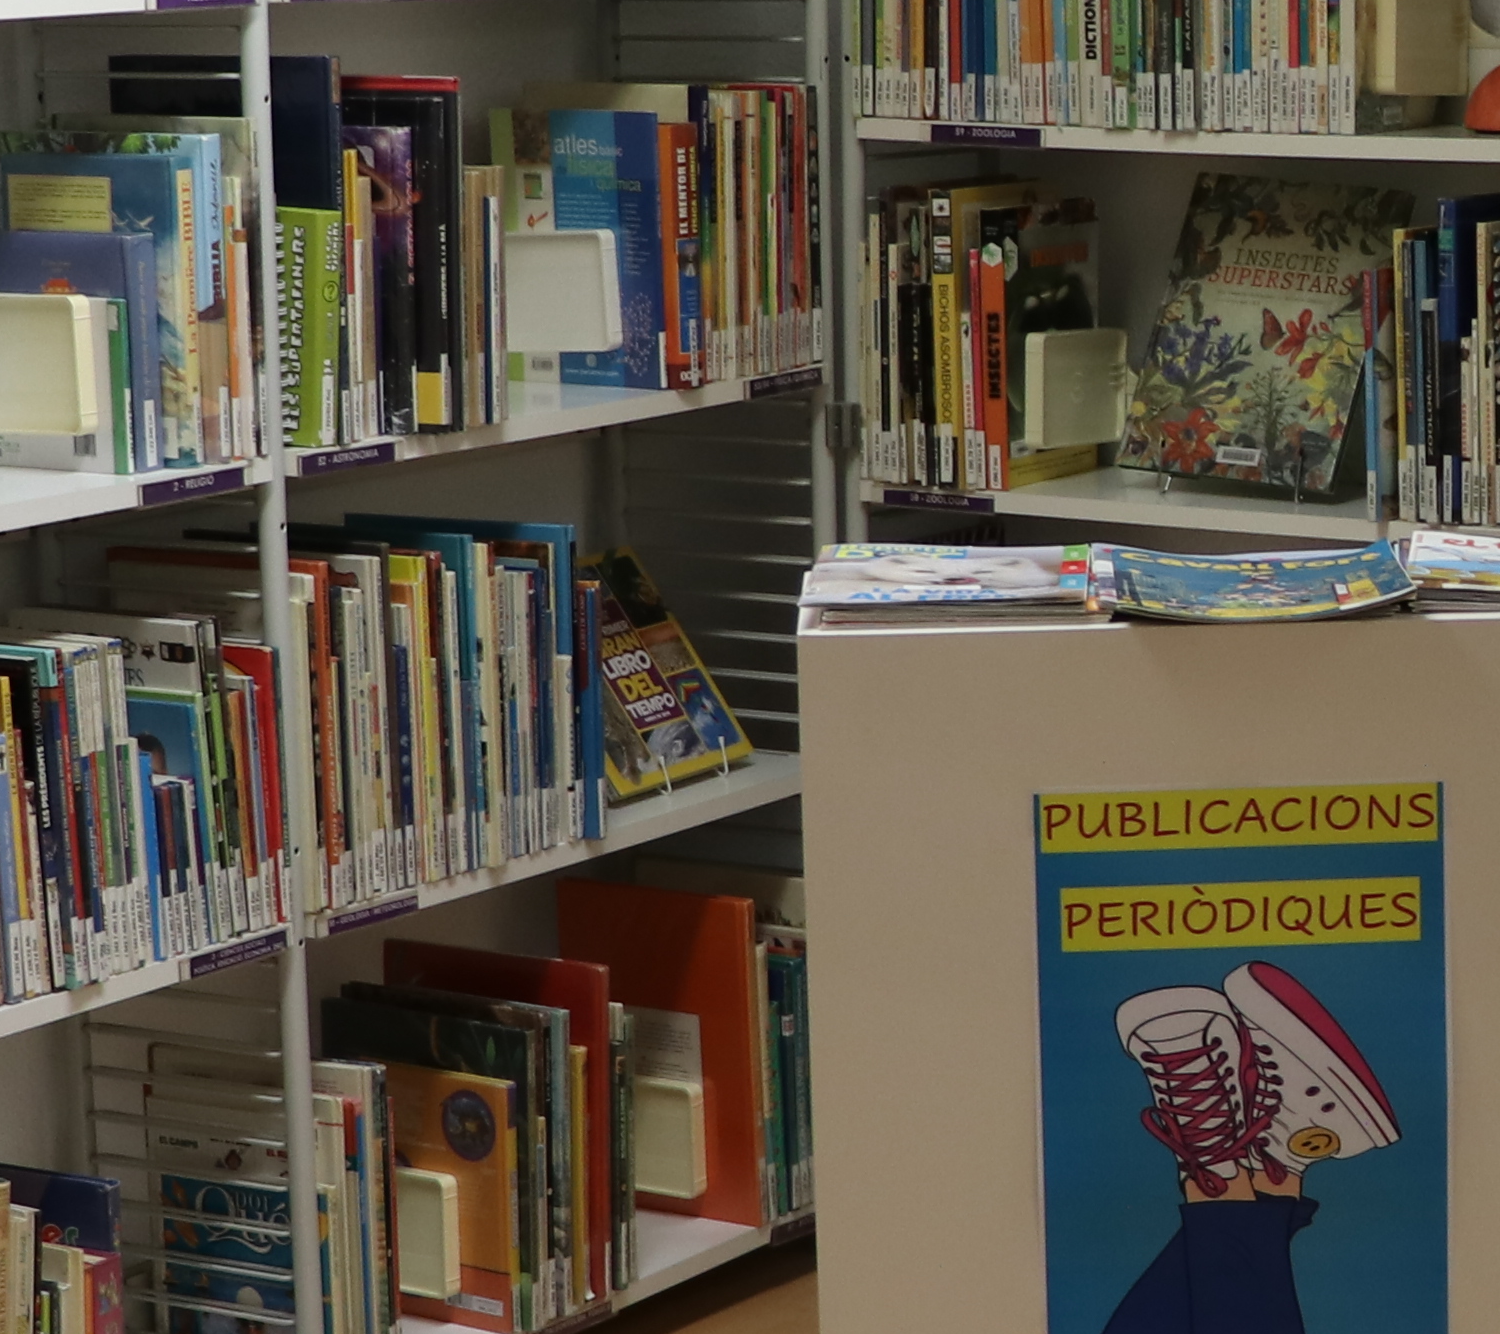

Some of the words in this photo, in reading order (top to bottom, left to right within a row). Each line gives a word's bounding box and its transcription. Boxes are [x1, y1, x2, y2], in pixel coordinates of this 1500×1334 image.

[553, 134, 599, 157] atles
[972, 127, 1017, 138] ZOOLOGIA
[676, 147, 687, 164] DE
[677, 170, 688, 218] MENTOR
[181, 181, 194, 242] BIBLE
[678, 221, 689, 235] EL
[1233, 247, 1340, 275] INSECTES
[185, 245, 196, 325] Première
[1207, 265, 1352, 297] SUPERSTARS
[284, 226, 306, 386] SUPERTAFANERS
[987, 311, 1001, 398] INSECTES
[285, 394, 301, 432] ELS
[331, 448, 380, 466] ASTRONOMIA
[925, 493, 970, 506] ZOOLOGIA
[602, 649, 652, 681] LIBRO
[616, 670, 665, 702] DEL
[625, 692, 676, 719] TIEMPO
[42, 808, 52, 829] LES
[1043, 793, 1435, 841] PUBLICACIONS
[1064, 885, 1418, 940] PERIÒDIQUES
[169, 1137, 199, 1149] CAMPO
[235, 1192, 269, 1213] por
